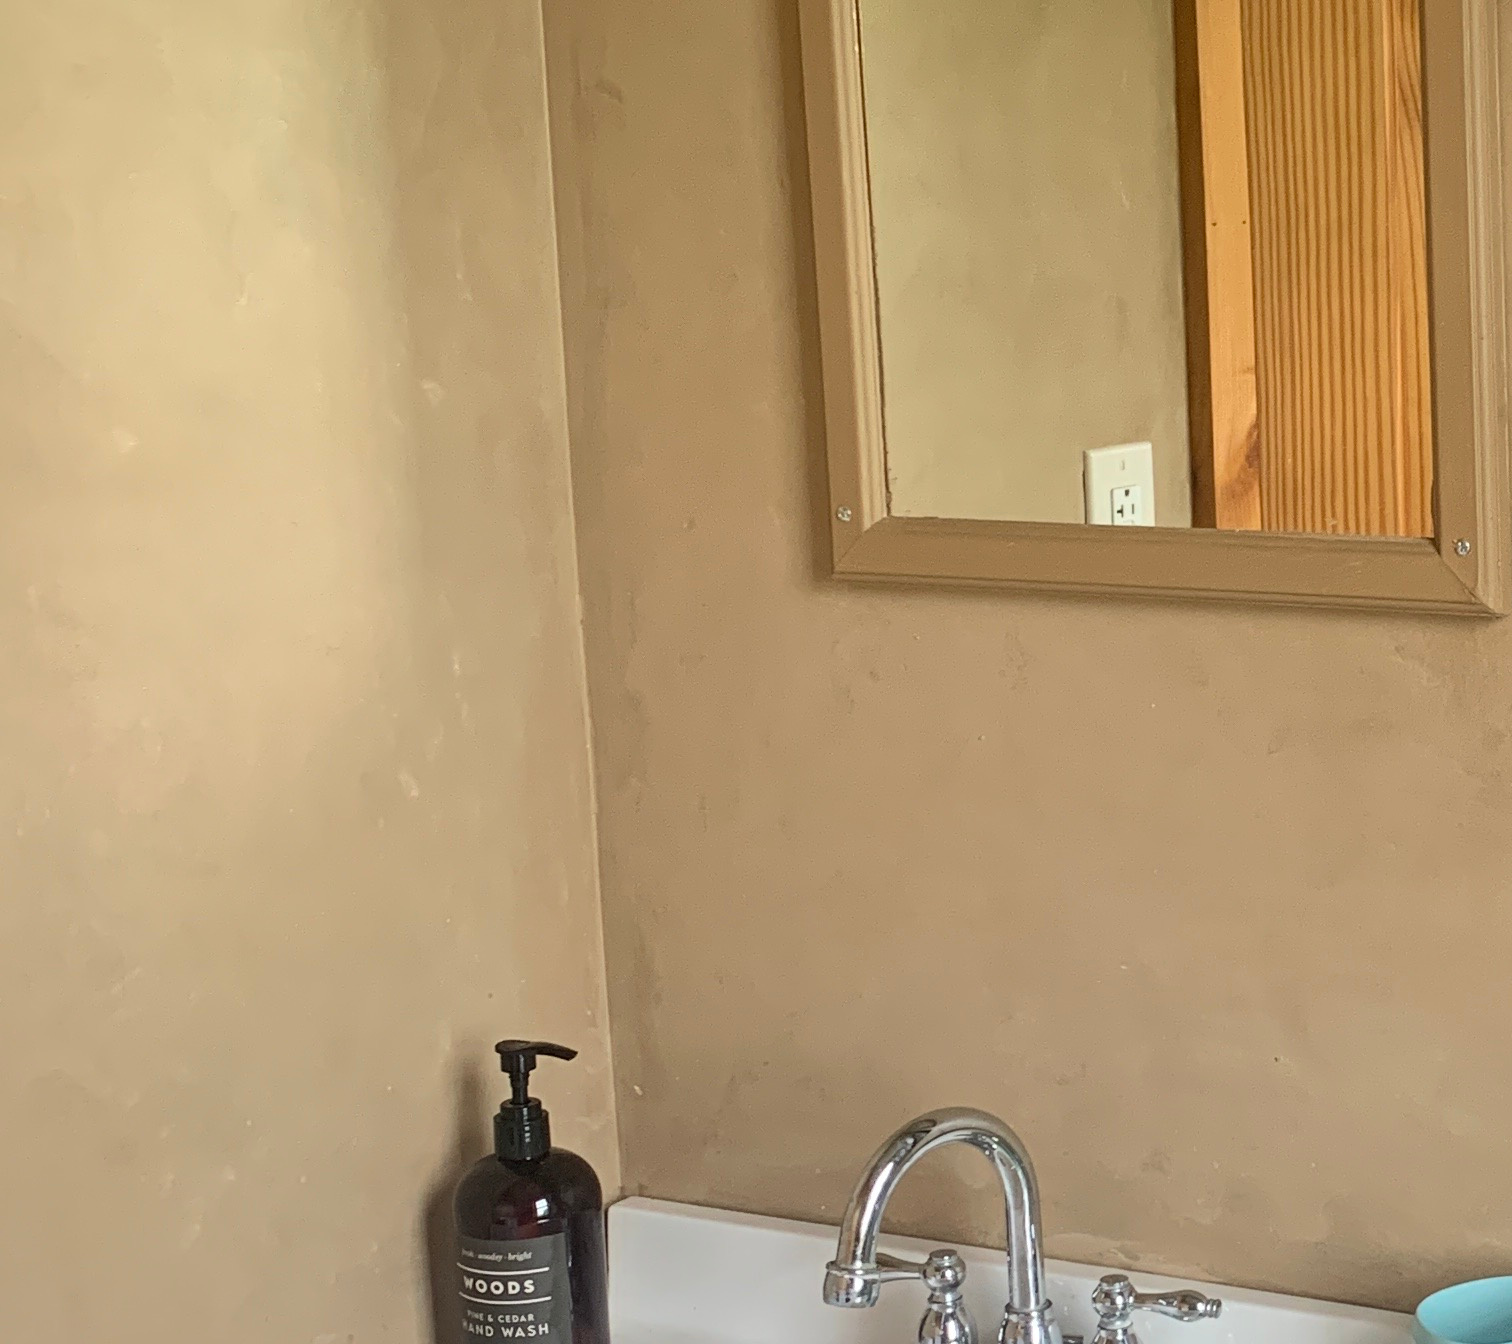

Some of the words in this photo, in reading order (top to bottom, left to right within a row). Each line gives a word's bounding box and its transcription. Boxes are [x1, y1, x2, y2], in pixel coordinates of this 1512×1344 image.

[463, 1275, 535, 1295] WOODS
[498, 1313, 535, 1324] CEDAR
[501, 1322, 549, 1338] WASH
